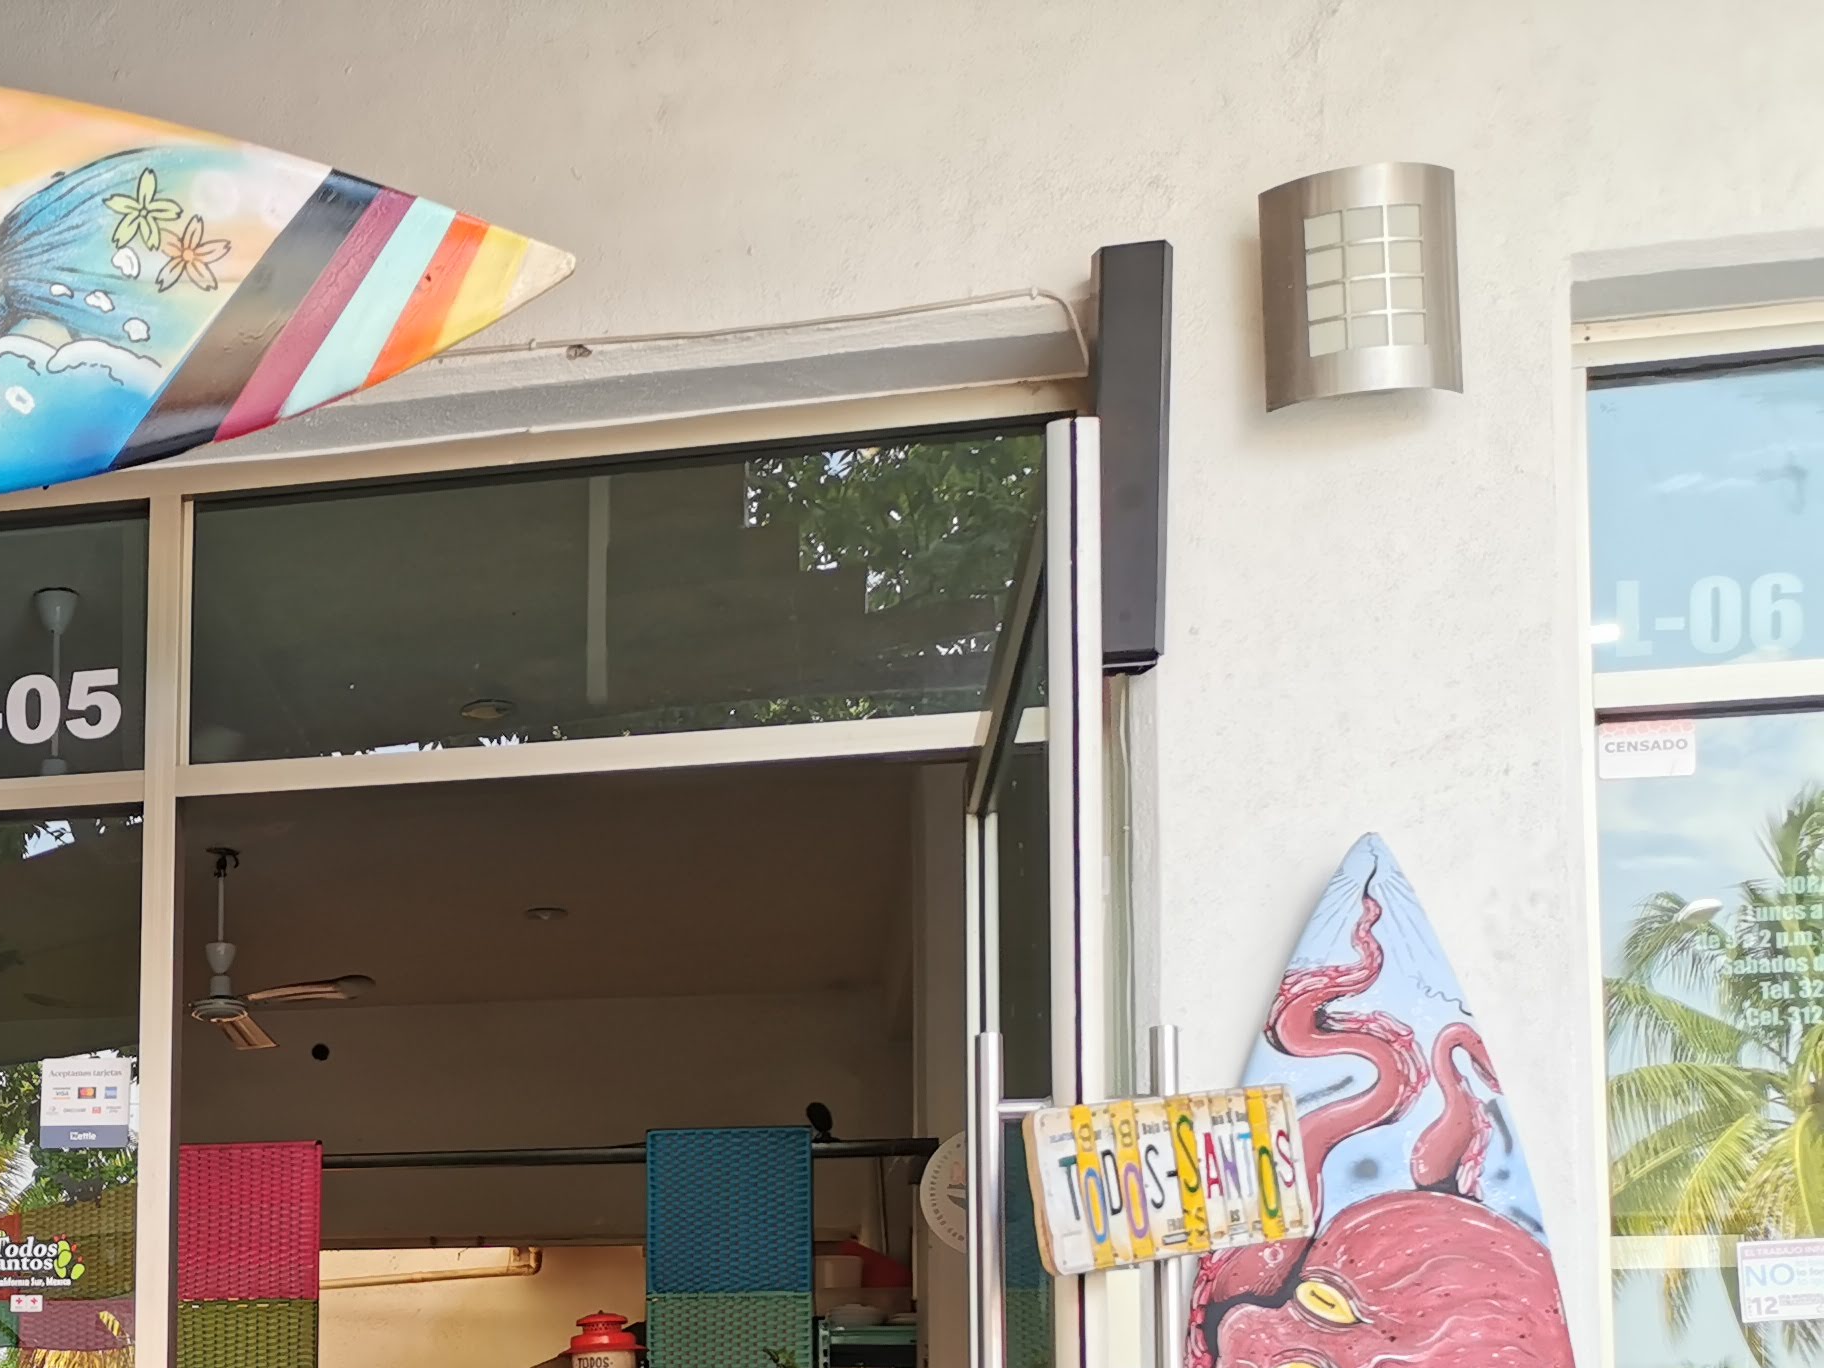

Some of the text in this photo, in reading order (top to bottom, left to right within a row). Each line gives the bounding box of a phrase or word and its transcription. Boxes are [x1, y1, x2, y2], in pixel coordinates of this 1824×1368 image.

[1614, 572, 1804, 658] L-06
[1604, 737, 1689, 754] CENSADO
[1759, 981, 1796, 1000] Tel.
[1745, 1007, 1785, 1027] Cel.
[92, 1068, 123, 1078] tarjetas
[1744, 1262, 1795, 1288] NO
[1750, 1296, 1780, 1316] 12
